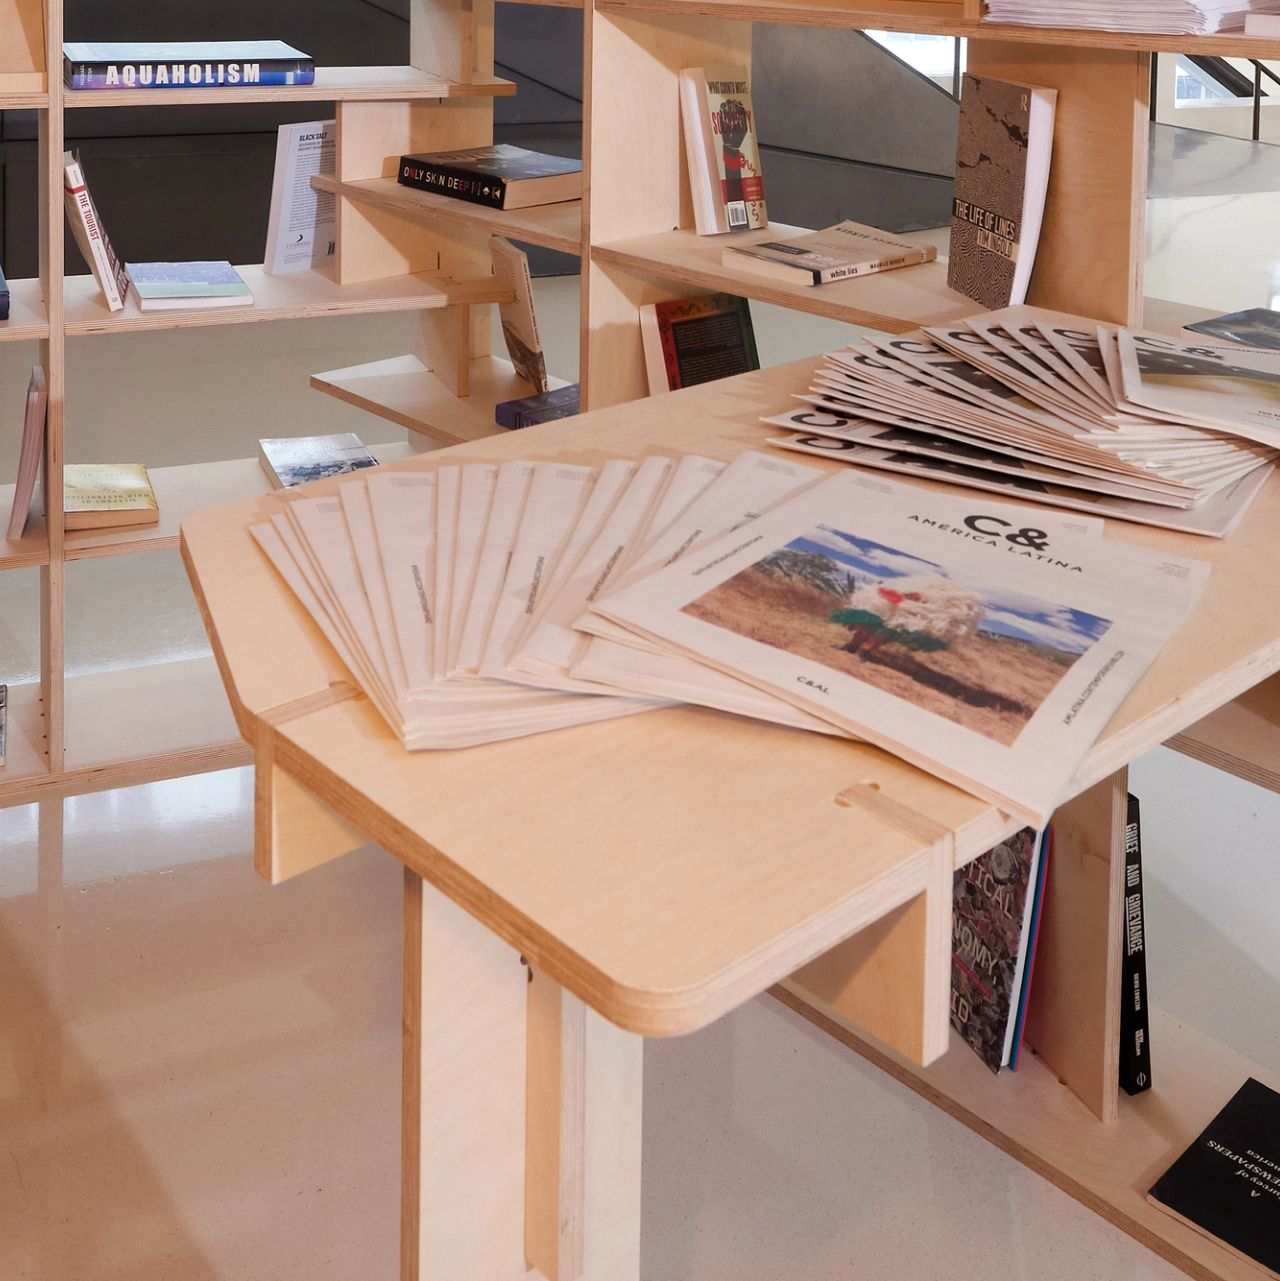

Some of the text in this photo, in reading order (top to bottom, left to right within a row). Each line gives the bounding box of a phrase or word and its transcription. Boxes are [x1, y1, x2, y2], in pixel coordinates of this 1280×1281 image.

[105, 62, 261, 88] AQUAHOLISM
[299, 132, 328, 142] BLACK SALT
[403, 166, 424, 181] ONLY
[447, 177, 470, 193] DEEP
[78, 192, 100, 241] THE TOURIST
[955, 199, 1016, 240] THE LIFE OF LINES
[977, 228, 1013, 258] TIM INGOLD
[829, 266, 858, 279] white lies
[1132, 335, 1225, 361] C&
[963, 514, 1051, 552] C&
[1008, 545, 1084, 573] LATINA
[796, 675, 832, 696] C&AL
[1126, 822, 1143, 955] GRIEF AND GRIEVANCE
[1234, 1169, 1249, 1178] of
[1249, 1189, 1261, 1198] A
